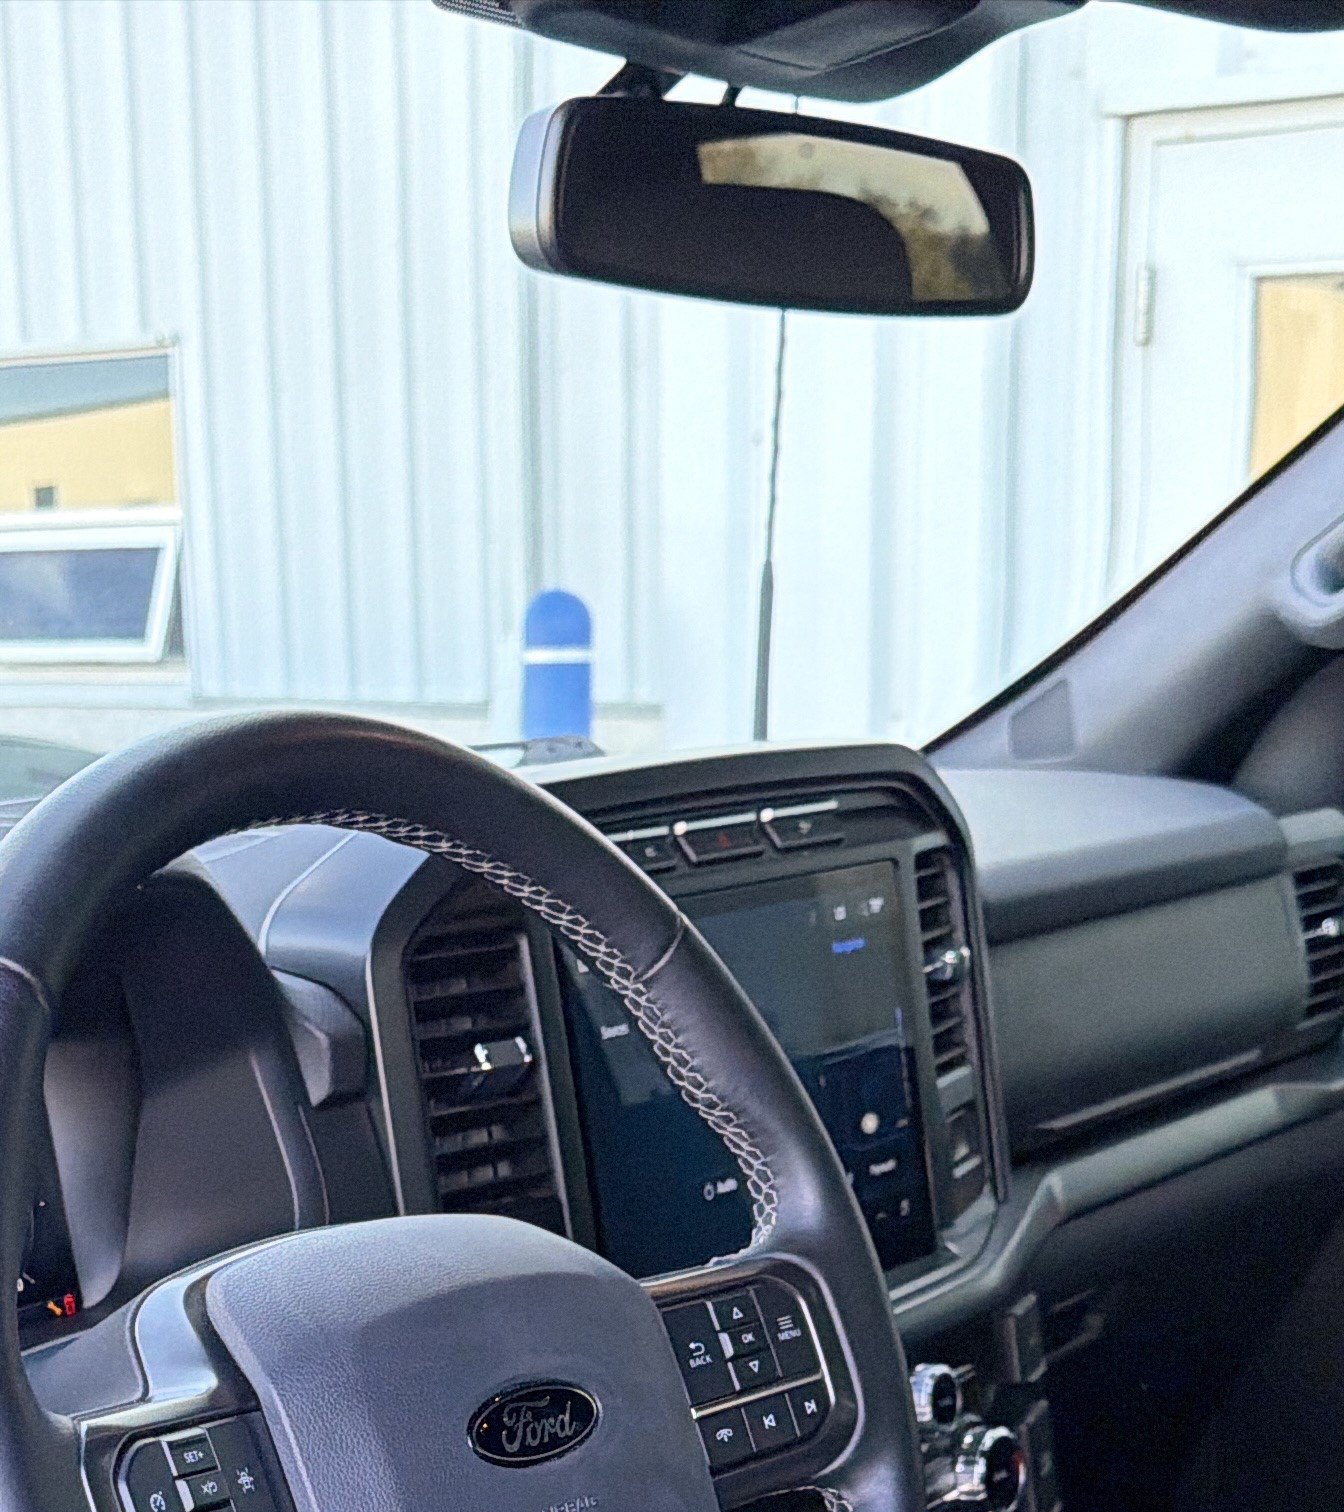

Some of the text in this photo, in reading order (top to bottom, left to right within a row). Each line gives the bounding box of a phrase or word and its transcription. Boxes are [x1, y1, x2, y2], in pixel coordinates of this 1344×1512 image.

[741, 1332, 756, 1344] OK
[777, 1328, 802, 1342] MENU
[689, 1354, 713, 1369] BACK
[501, 1395, 577, 1454] Ford
